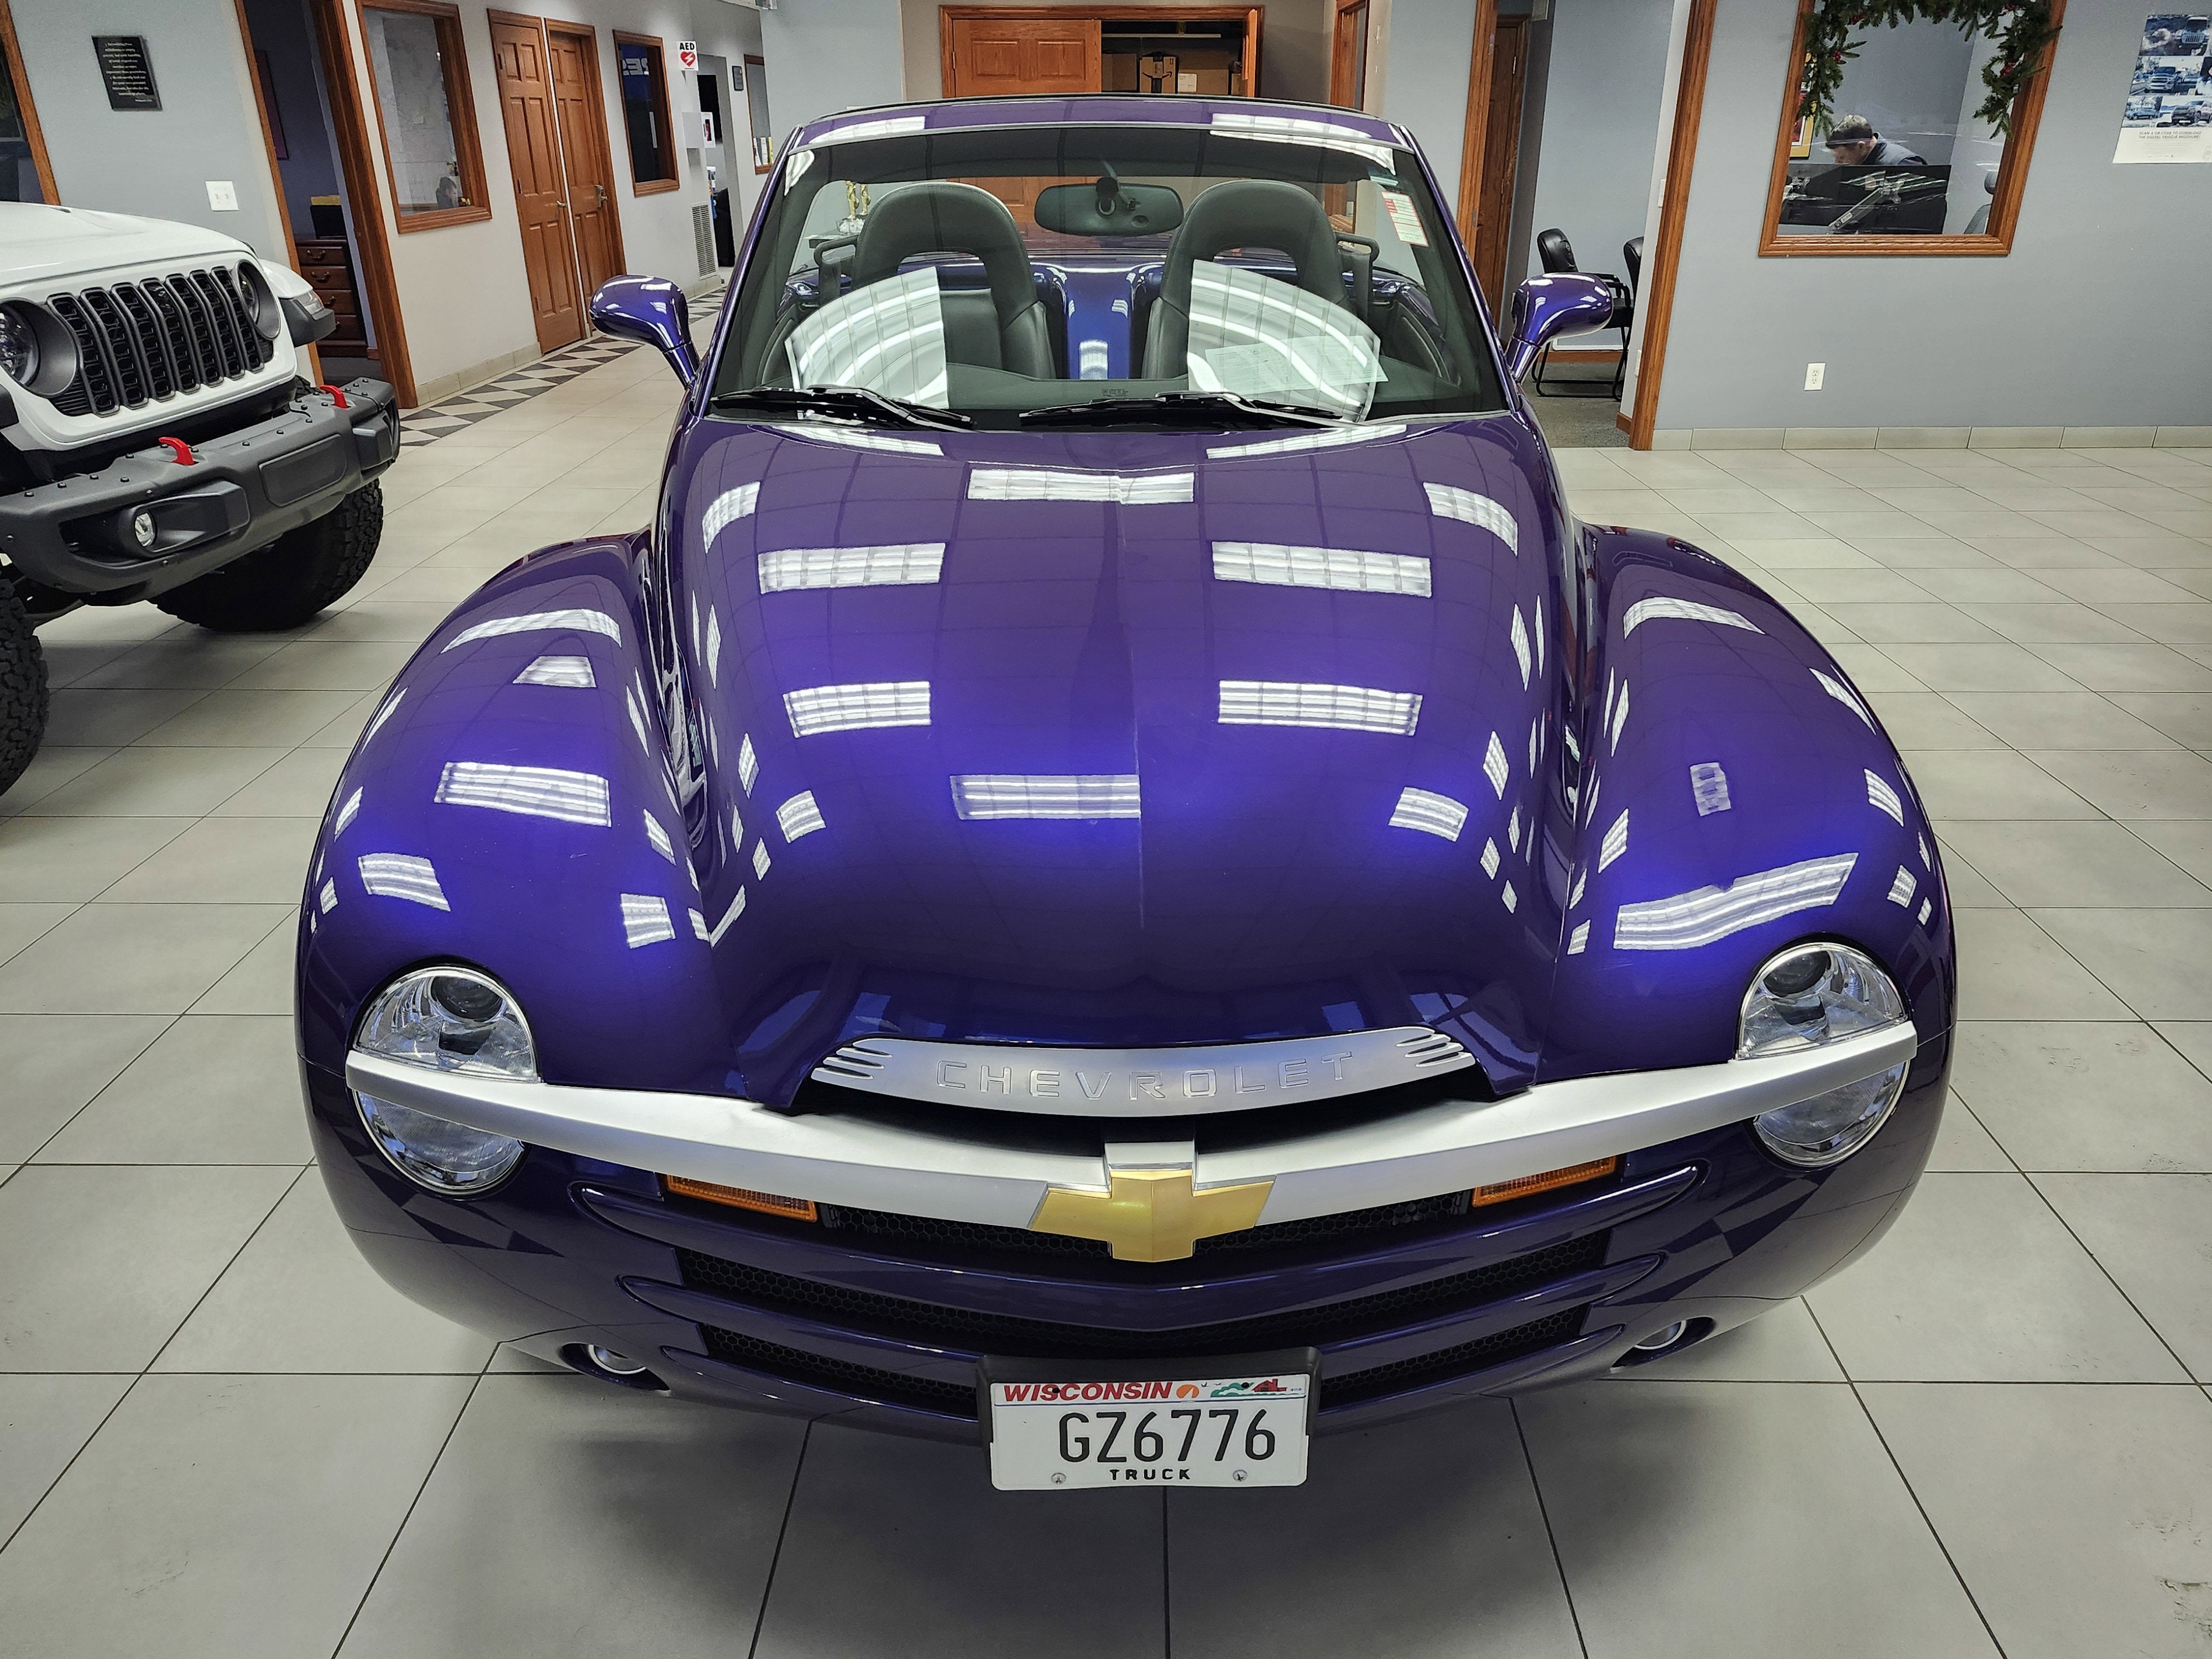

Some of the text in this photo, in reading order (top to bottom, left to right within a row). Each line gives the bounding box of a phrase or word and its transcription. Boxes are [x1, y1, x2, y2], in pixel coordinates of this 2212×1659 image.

[936, 1051, 1353, 1100] CHEVROLET
[1004, 1382, 1173, 1402] WISCONSIN
[1059, 1409, 1276, 1463] GZ6776
[1109, 1468, 1191, 1481] TRUCK
